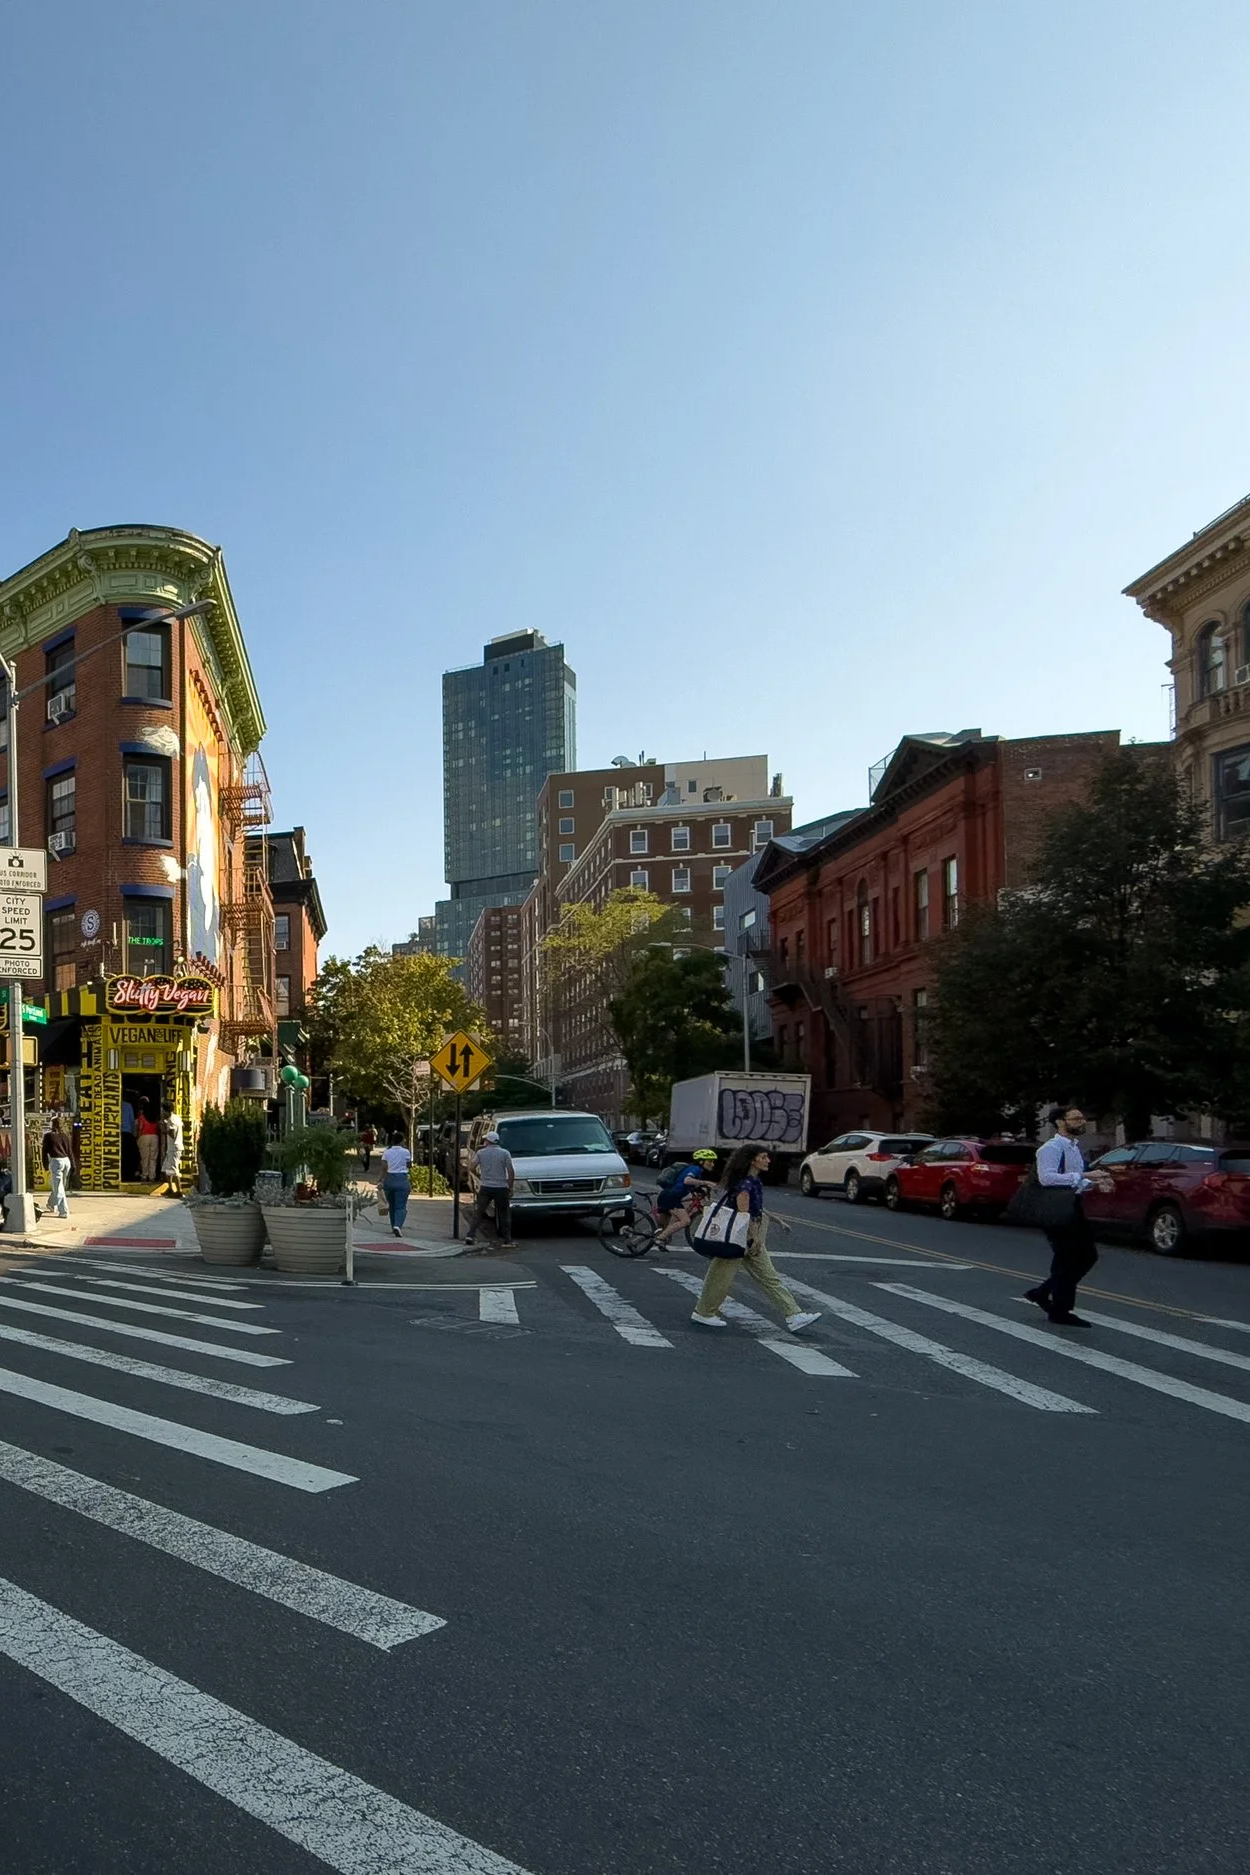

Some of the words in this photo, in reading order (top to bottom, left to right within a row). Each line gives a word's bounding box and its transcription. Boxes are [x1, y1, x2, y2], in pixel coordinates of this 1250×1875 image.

[11, 880, 41, 888] ENFORCED
[1, 907, 30, 915] SPEED
[5, 897, 26, 905] CITY
[4, 917, 28, 925] LIMIT
[0, 927, 36, 951] 25
[128, 937, 141, 945] THE
[113, 979, 160, 1010] Slutty
[157, 981, 210, 1010] Vegan
[110, 1026, 156, 1044] VEGAN
[164, 1029, 183, 1044] LIFE
[92, 1026, 102, 1072] ANIMALS
[94, 1075, 102, 1099] DEAD
[103, 1072, 119, 1113] PLANTS
[94, 1104, 102, 1122] EAT
[80, 1118, 92, 1146] CURB
[94, 1126, 102, 1138] TO
[80, 1149, 92, 1170] THE
[94, 1142, 102, 1167] CUTE
[103, 1122, 119, 1190] POWERED
